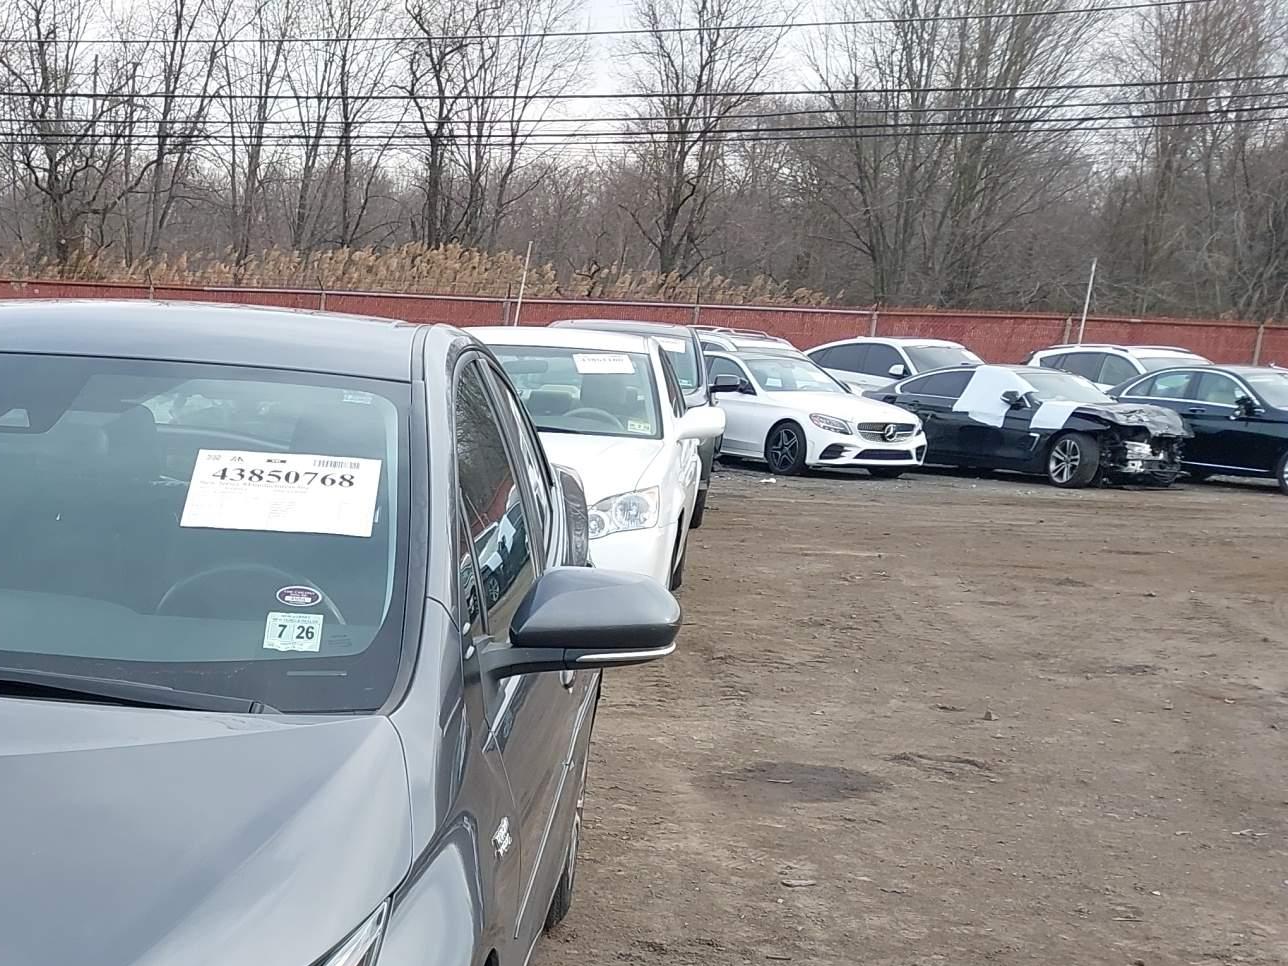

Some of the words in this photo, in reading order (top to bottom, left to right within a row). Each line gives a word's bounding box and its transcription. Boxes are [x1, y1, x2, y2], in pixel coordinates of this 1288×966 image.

[211, 467, 355, 488] 43850768
[278, 624, 287, 638] 7
[296, 625, 314, 639] 26
